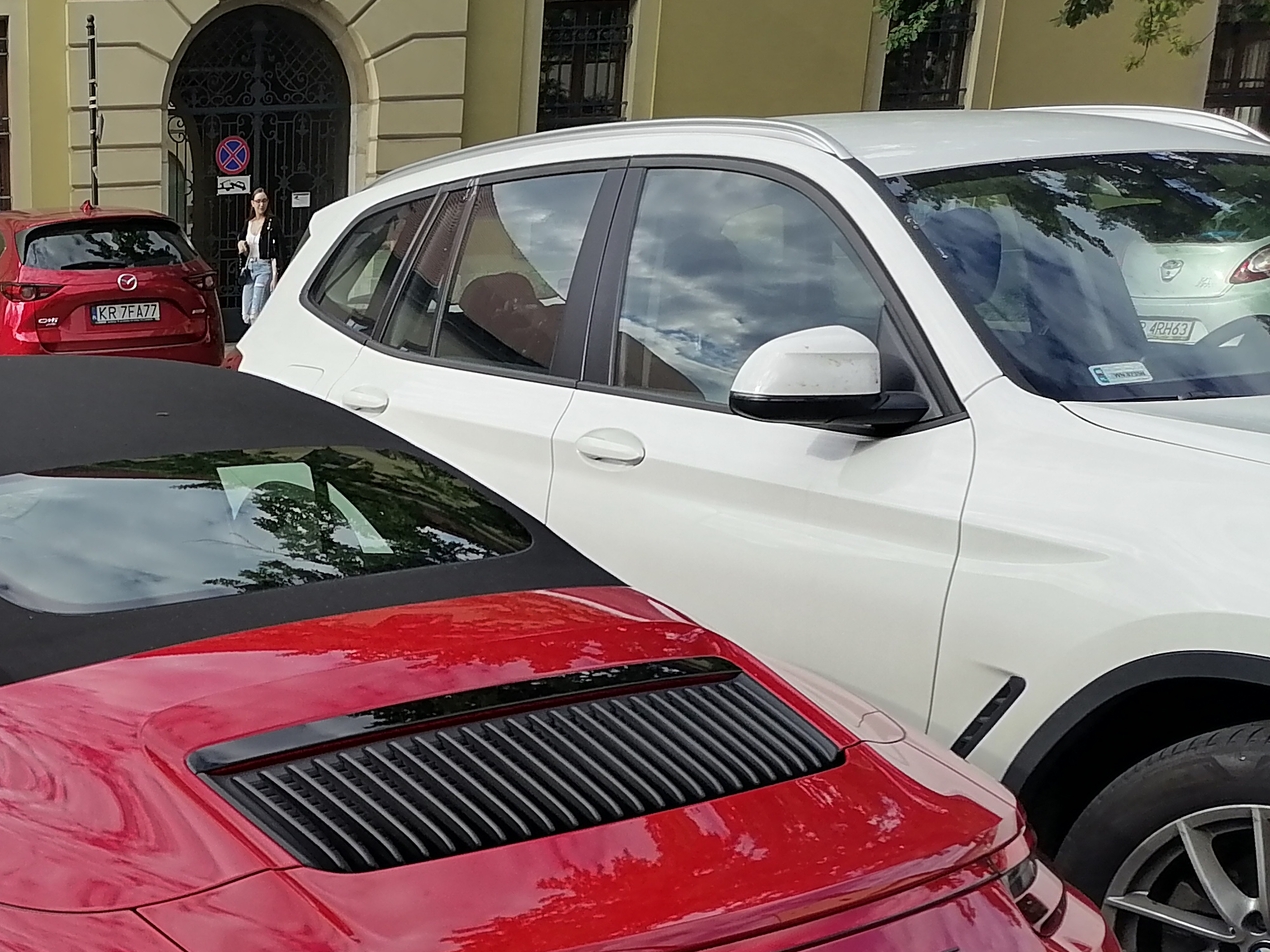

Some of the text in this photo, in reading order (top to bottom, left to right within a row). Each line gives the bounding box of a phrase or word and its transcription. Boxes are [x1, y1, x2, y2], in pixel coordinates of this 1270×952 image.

[99, 306, 117, 320] KR
[120, 303, 157, 319] 7FA77
[1149, 321, 1189, 336] 4RH63
